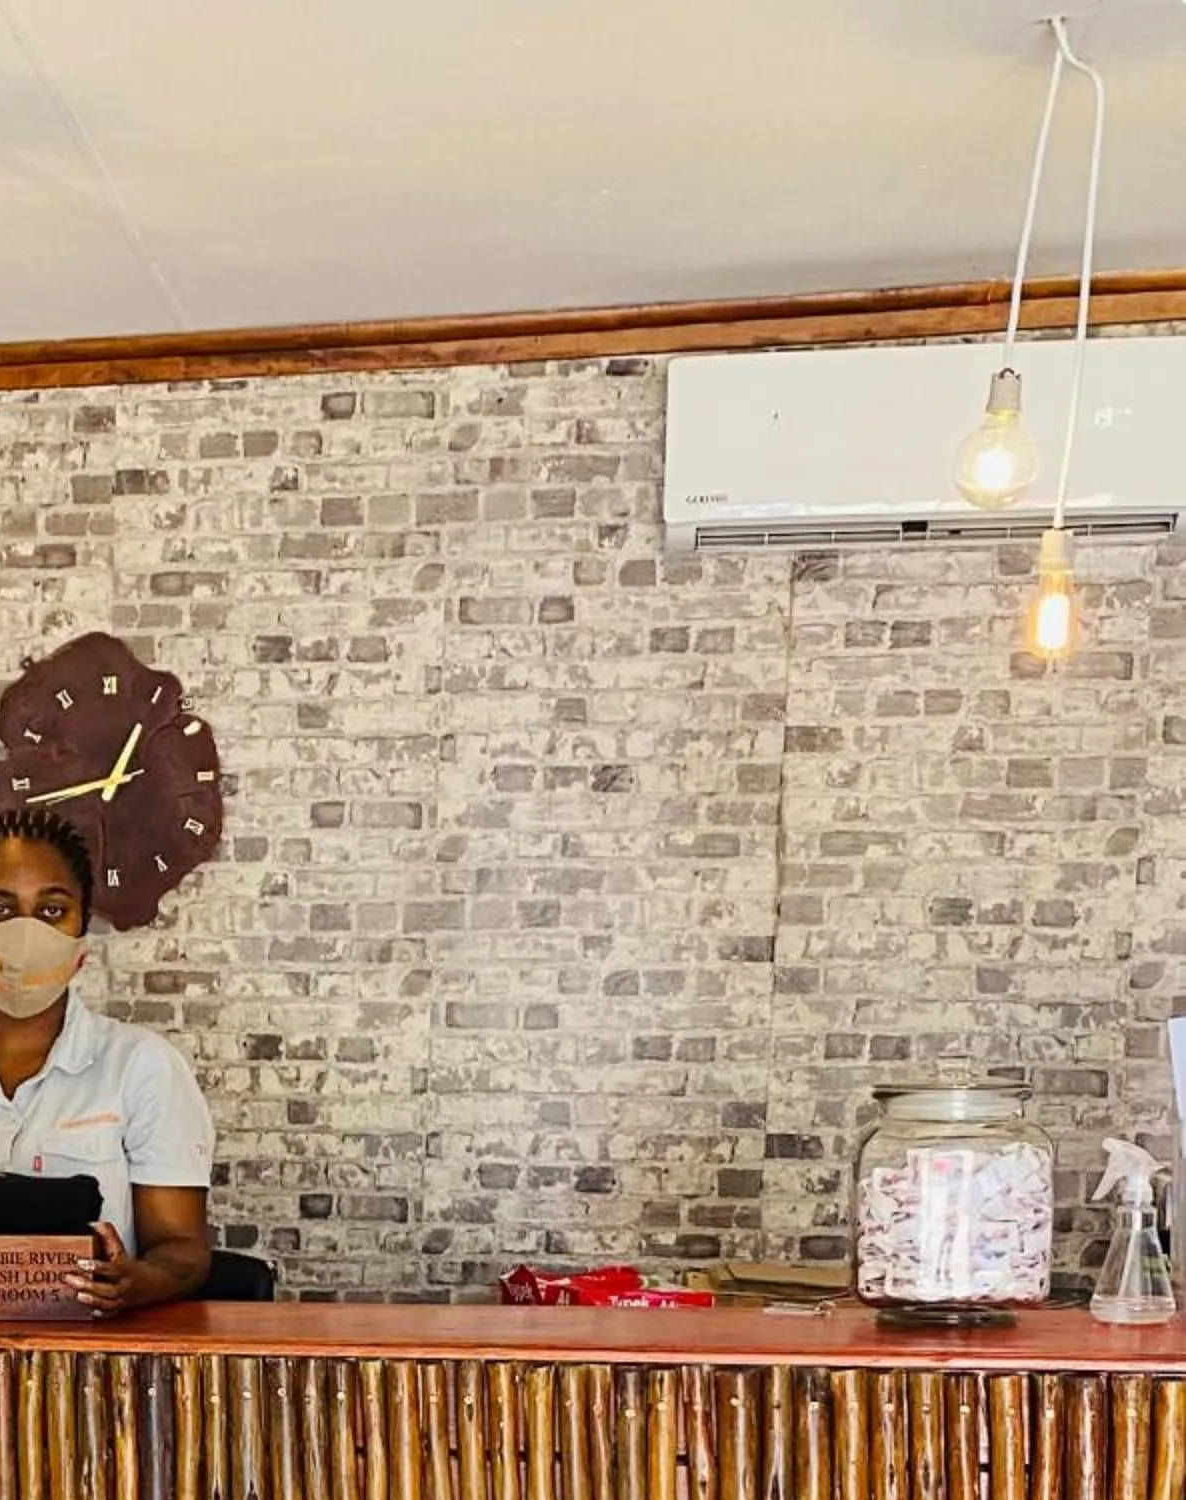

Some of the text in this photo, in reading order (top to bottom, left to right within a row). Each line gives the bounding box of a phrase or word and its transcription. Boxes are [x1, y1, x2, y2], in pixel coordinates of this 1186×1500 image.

[29, 1251, 77, 1266] RIVER
[25, 1270, 69, 1285] LODG
[51, 1289, 60, 1303] 5
